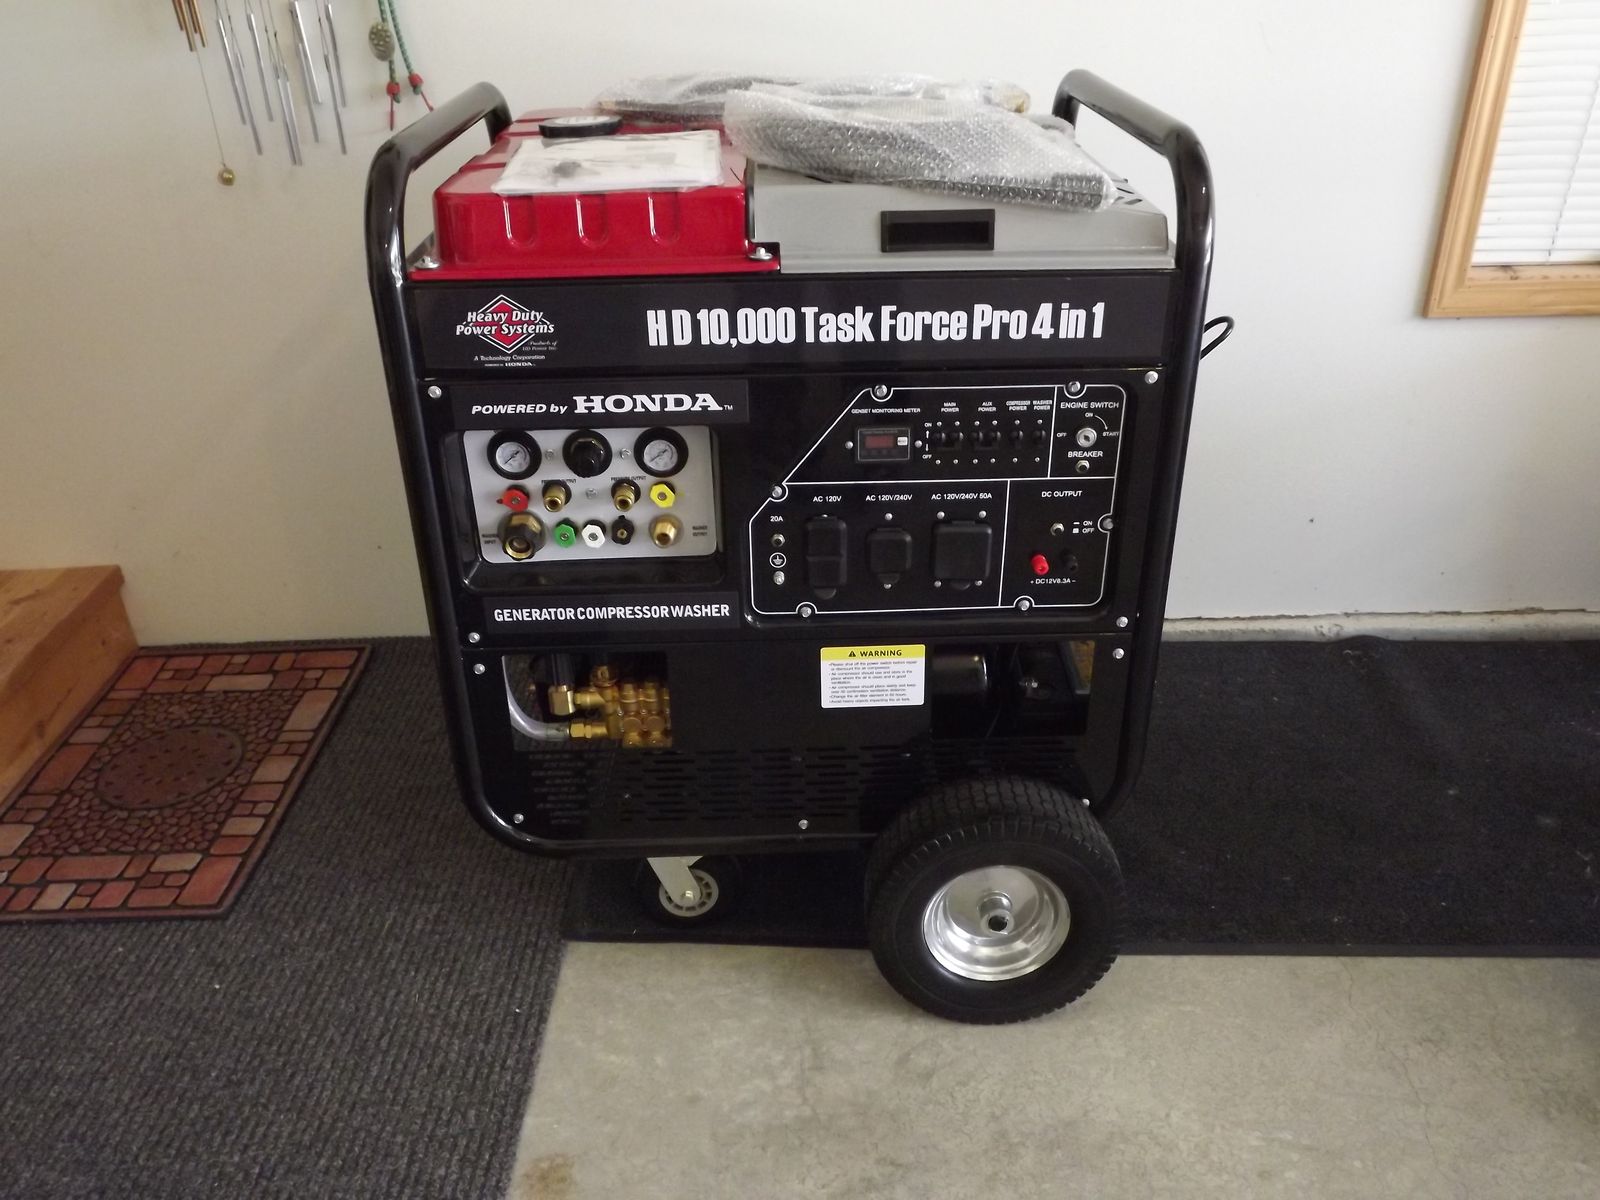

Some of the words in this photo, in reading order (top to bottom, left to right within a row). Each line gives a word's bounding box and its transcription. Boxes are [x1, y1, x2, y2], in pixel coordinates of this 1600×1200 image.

[467, 312, 508, 324] Heavy
[512, 310, 544, 323] Duty
[696, 306, 796, 349] 10,000
[800, 305, 876, 343] Task
[880, 303, 968, 342] Force
[972, 302, 1028, 341] Pro
[1030, 301, 1056, 341] 4
[1058, 301, 1088, 340] in
[1091, 301, 1106, 340] 1
[456, 325, 497, 335] Power
[501, 323, 555, 336] Systems
[471, 404, 548, 415] POWERED
[550, 404, 568, 415] by
[573, 393, 723, 415] HONDA
[493, 608, 575, 622] GENERATOR
[576, 606, 669, 620] COMPRESSOR
[671, 604, 730, 617] WASHER
